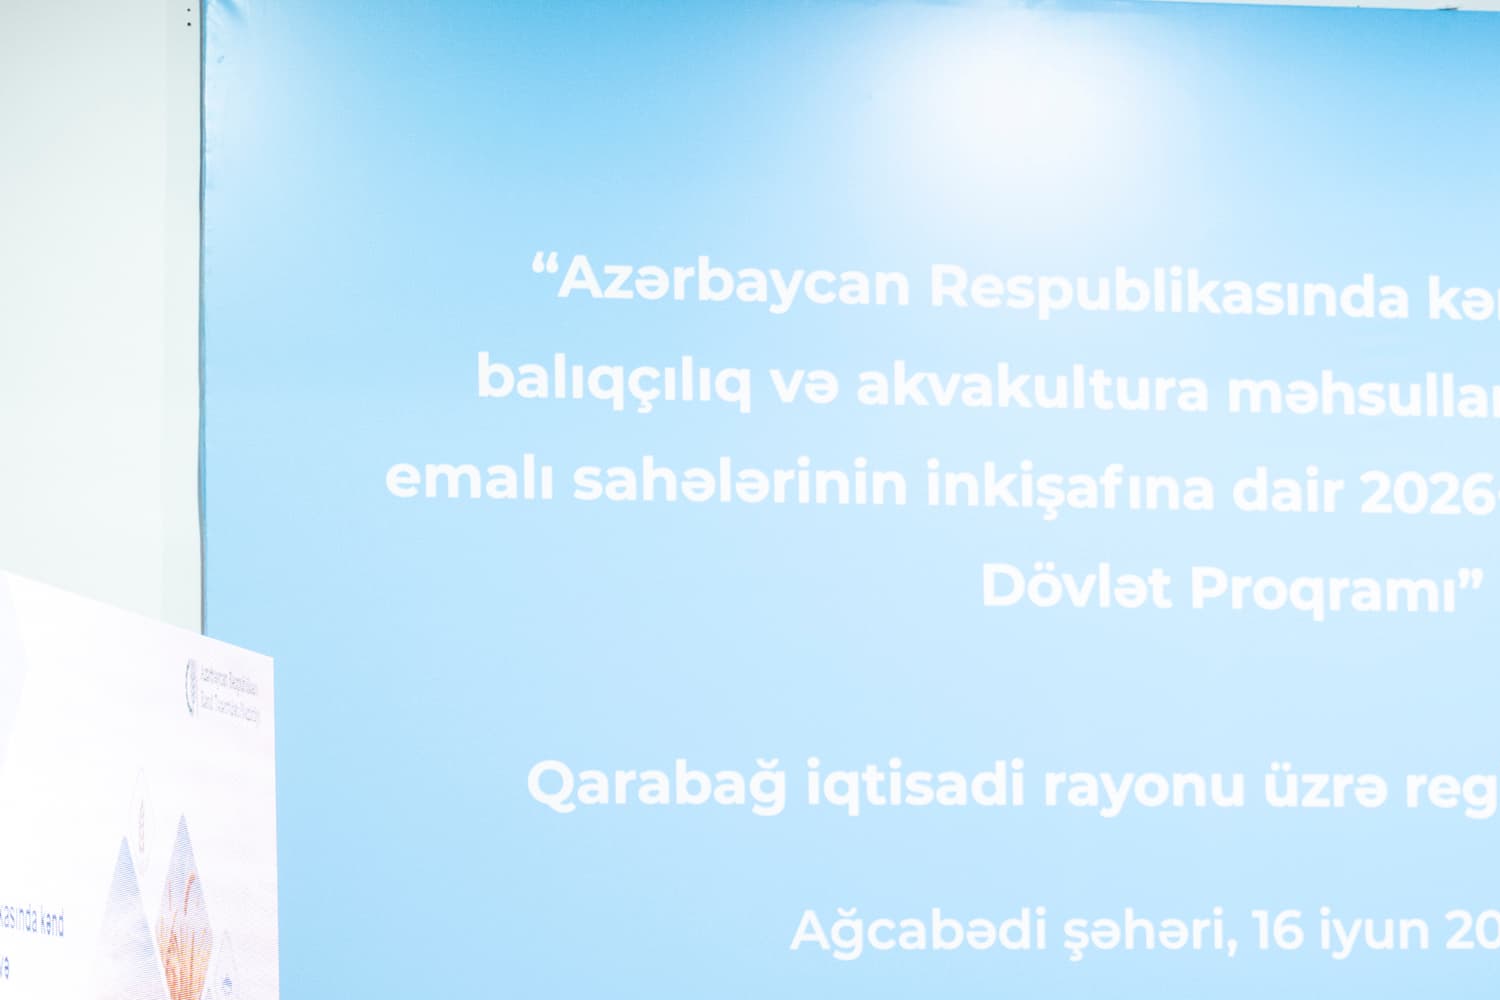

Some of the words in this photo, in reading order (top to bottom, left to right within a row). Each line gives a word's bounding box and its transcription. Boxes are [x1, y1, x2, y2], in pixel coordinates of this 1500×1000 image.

[532, 251, 908, 313] “Azərbaycan
[932, 264, 1408, 320] Respublikasında
[477, 352, 750, 413] balıqçılıq
[769, 370, 838, 403] və
[858, 361, 1207, 411] akvakultura
[386, 453, 552, 499] emalı
[574, 456, 906, 505] sahələrinin
[928, 458, 1213, 520] inkişafına
[1233, 465, 1344, 513] dair
[983, 562, 1172, 608] Dövlət
[1192, 567, 1483, 621] Proqramı”
[528, 758, 785, 816] Qarabağ
[808, 757, 1024, 816] iqtisadi
[1046, 773, 1244, 817] rayonu
[1265, 762, 1387, 807] üzrə
[790, 906, 1046, 960] Ağcabədi
[1064, 906, 1237, 961] şəhəri,
[1252, 909, 1304, 949] 16
[1320, 906, 1429, 959] iyun
